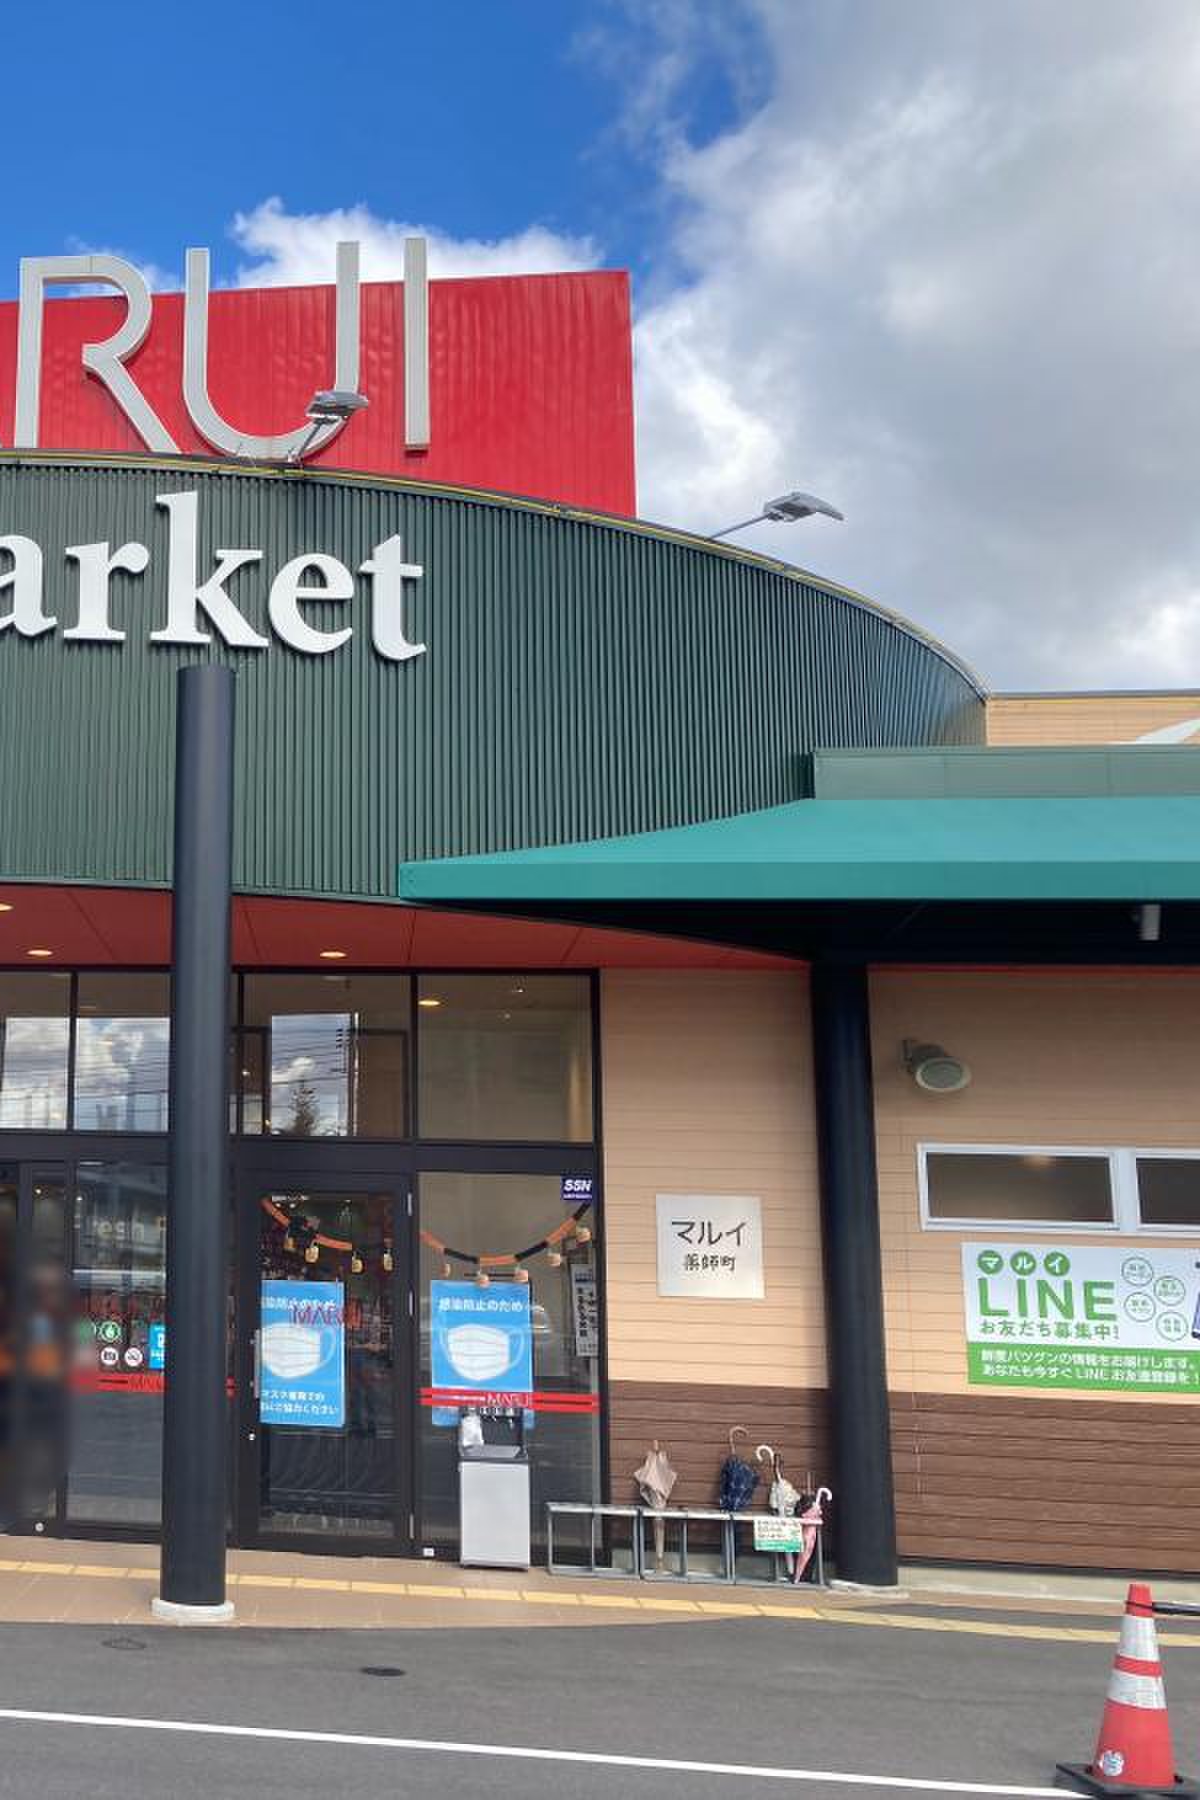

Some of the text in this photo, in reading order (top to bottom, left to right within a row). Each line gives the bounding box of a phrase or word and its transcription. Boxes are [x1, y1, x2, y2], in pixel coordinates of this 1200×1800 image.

[564, 1179, 592, 1192] SSN
[672, 1221, 746, 1247] マルイ
[684, 1253, 736, 1272] 薬師町
[979, 1252, 1068, 1275] マルイ
[978, 1277, 1118, 1321] LINE
